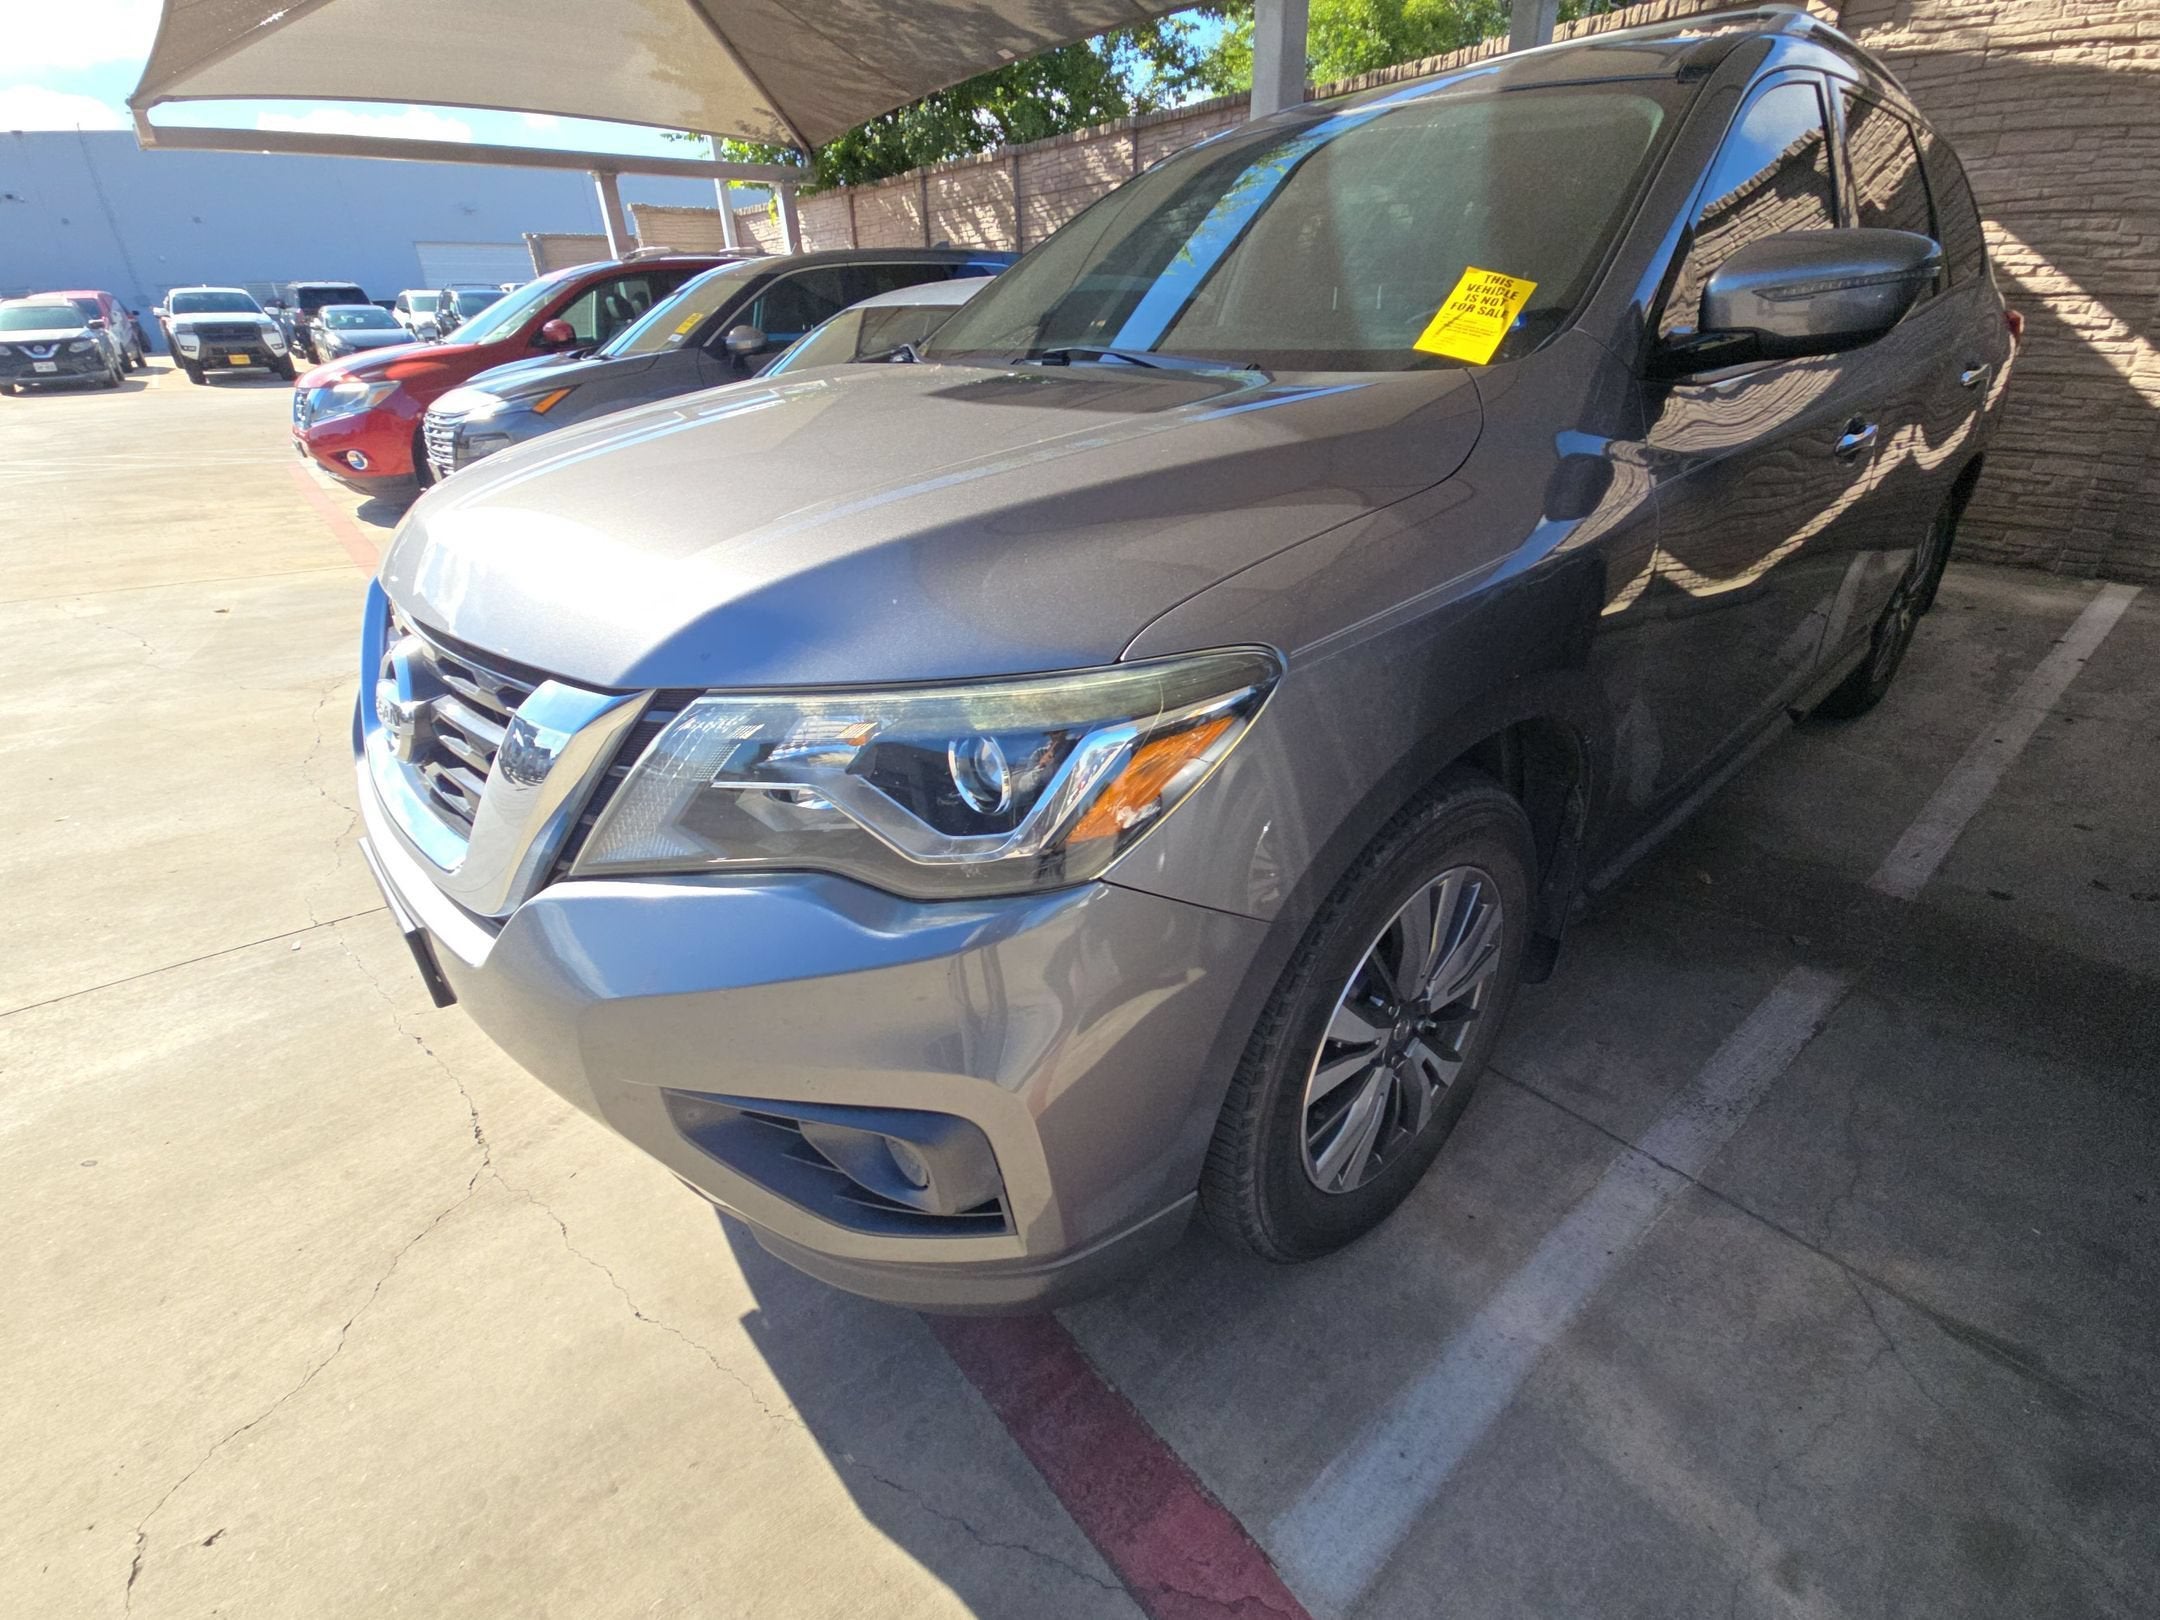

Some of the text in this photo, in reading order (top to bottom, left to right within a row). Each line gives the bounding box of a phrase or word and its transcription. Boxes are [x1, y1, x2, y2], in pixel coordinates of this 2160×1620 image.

[1484, 274, 1514, 288] THIS
[1466, 283, 1519, 301] VEHICLE
[1464, 293, 1509, 307] IS NOT
[1450, 302, 1510, 319] FOR SALE
